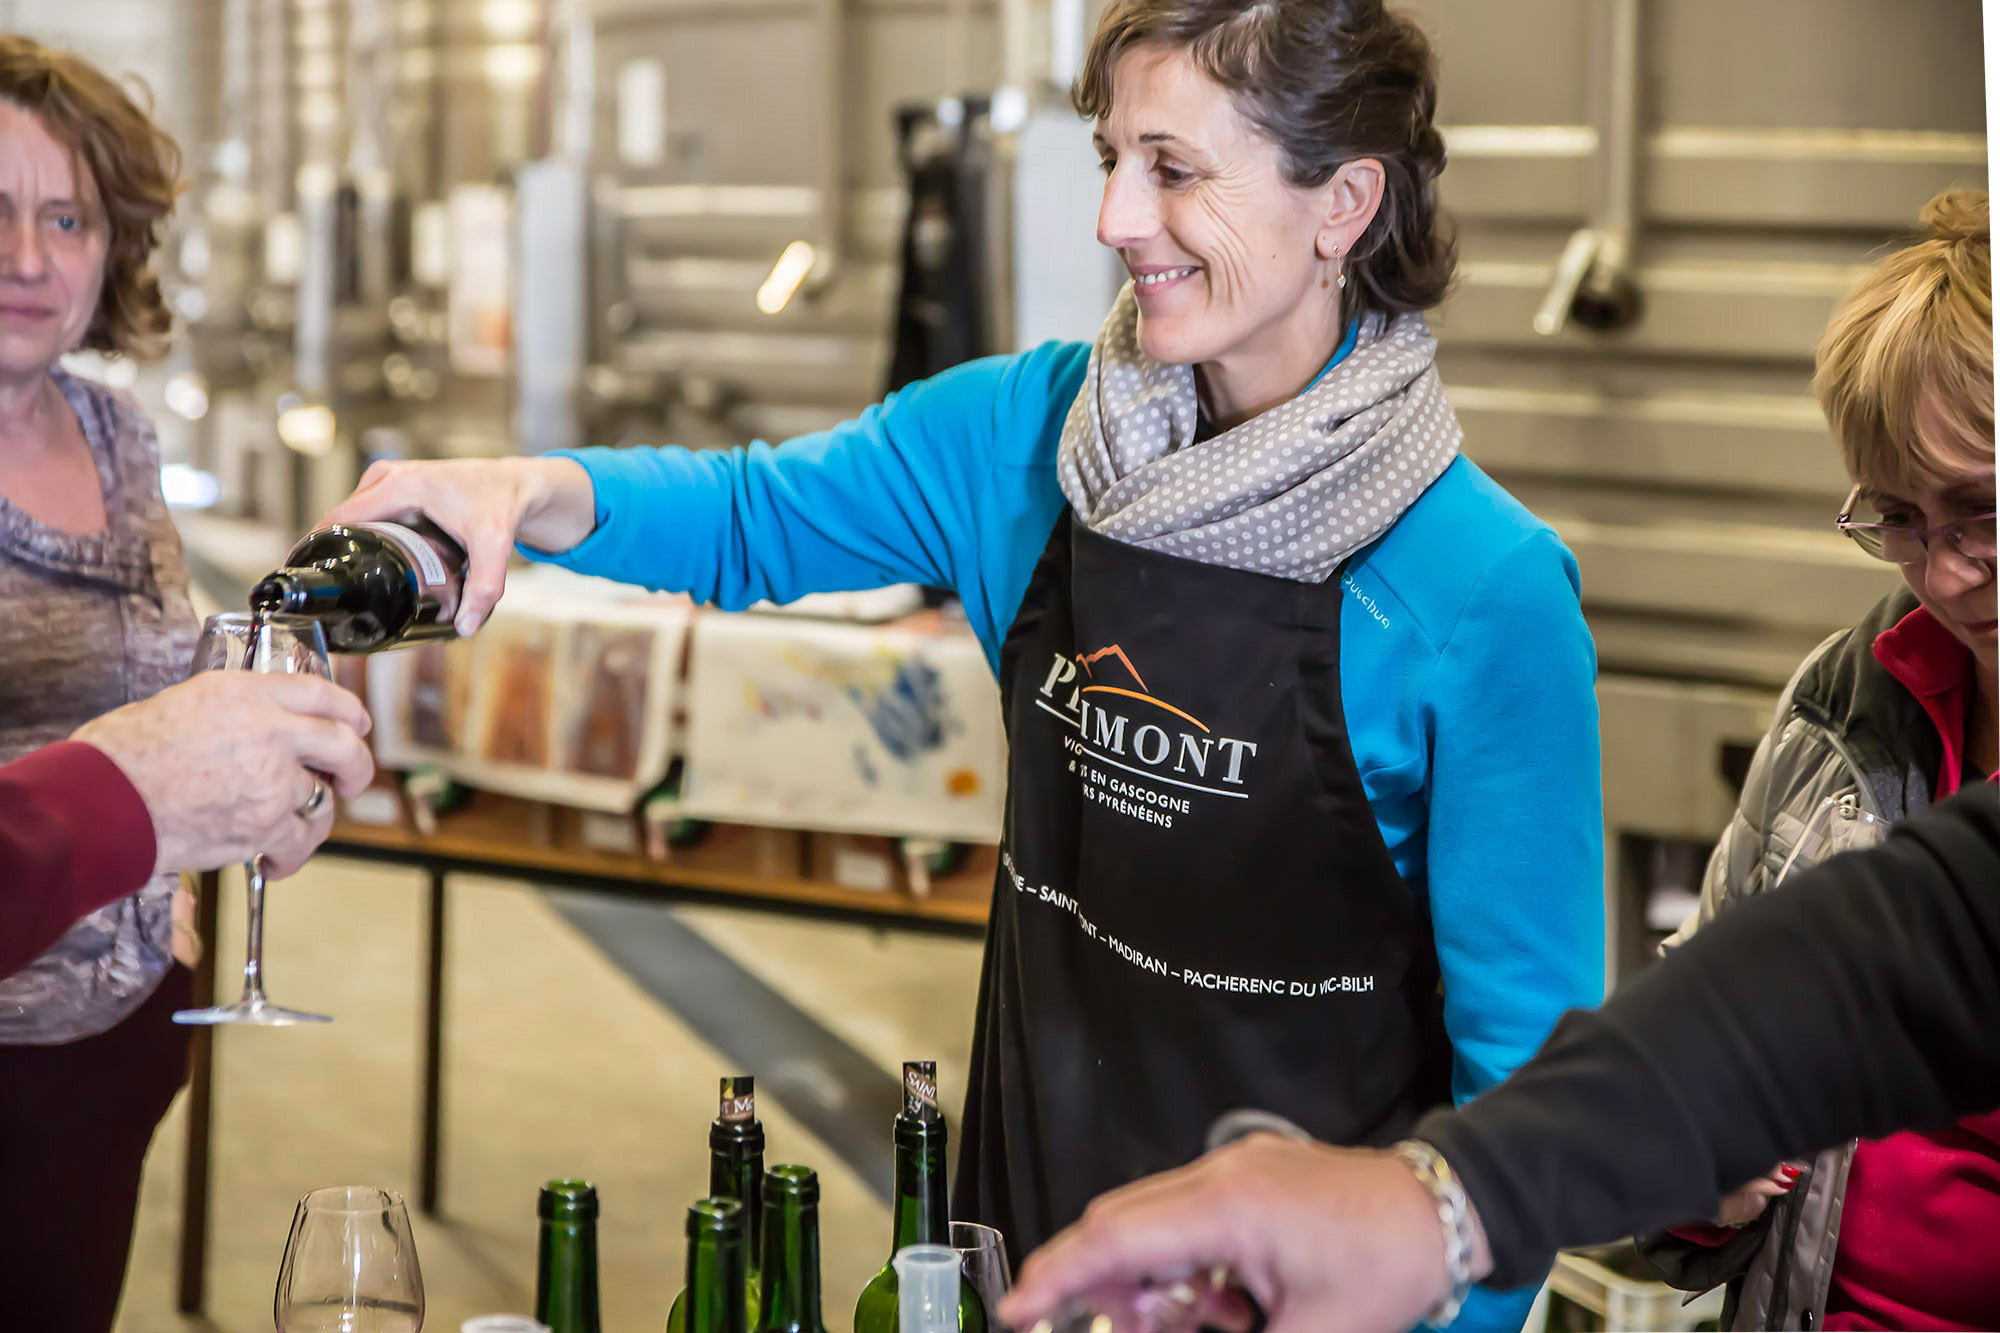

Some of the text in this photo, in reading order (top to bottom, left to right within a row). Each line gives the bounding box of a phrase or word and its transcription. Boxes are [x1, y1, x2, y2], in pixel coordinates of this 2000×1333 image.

[1091, 769, 1107, 787] EN
[1109, 778, 1191, 815] GASCOGNE
[1098, 790, 1173, 829] PYRÉNÉENS
[1039, 885, 1079, 915] SAINT
[1078, 907, 1098, 939] ONT
[1108, 934, 1167, 977] MADIRAN
[1183, 968, 1286, 995] PACHERENC
[1289, 981, 1317, 998] DU
[1319, 975, 1375, 996] VIC-BILH
